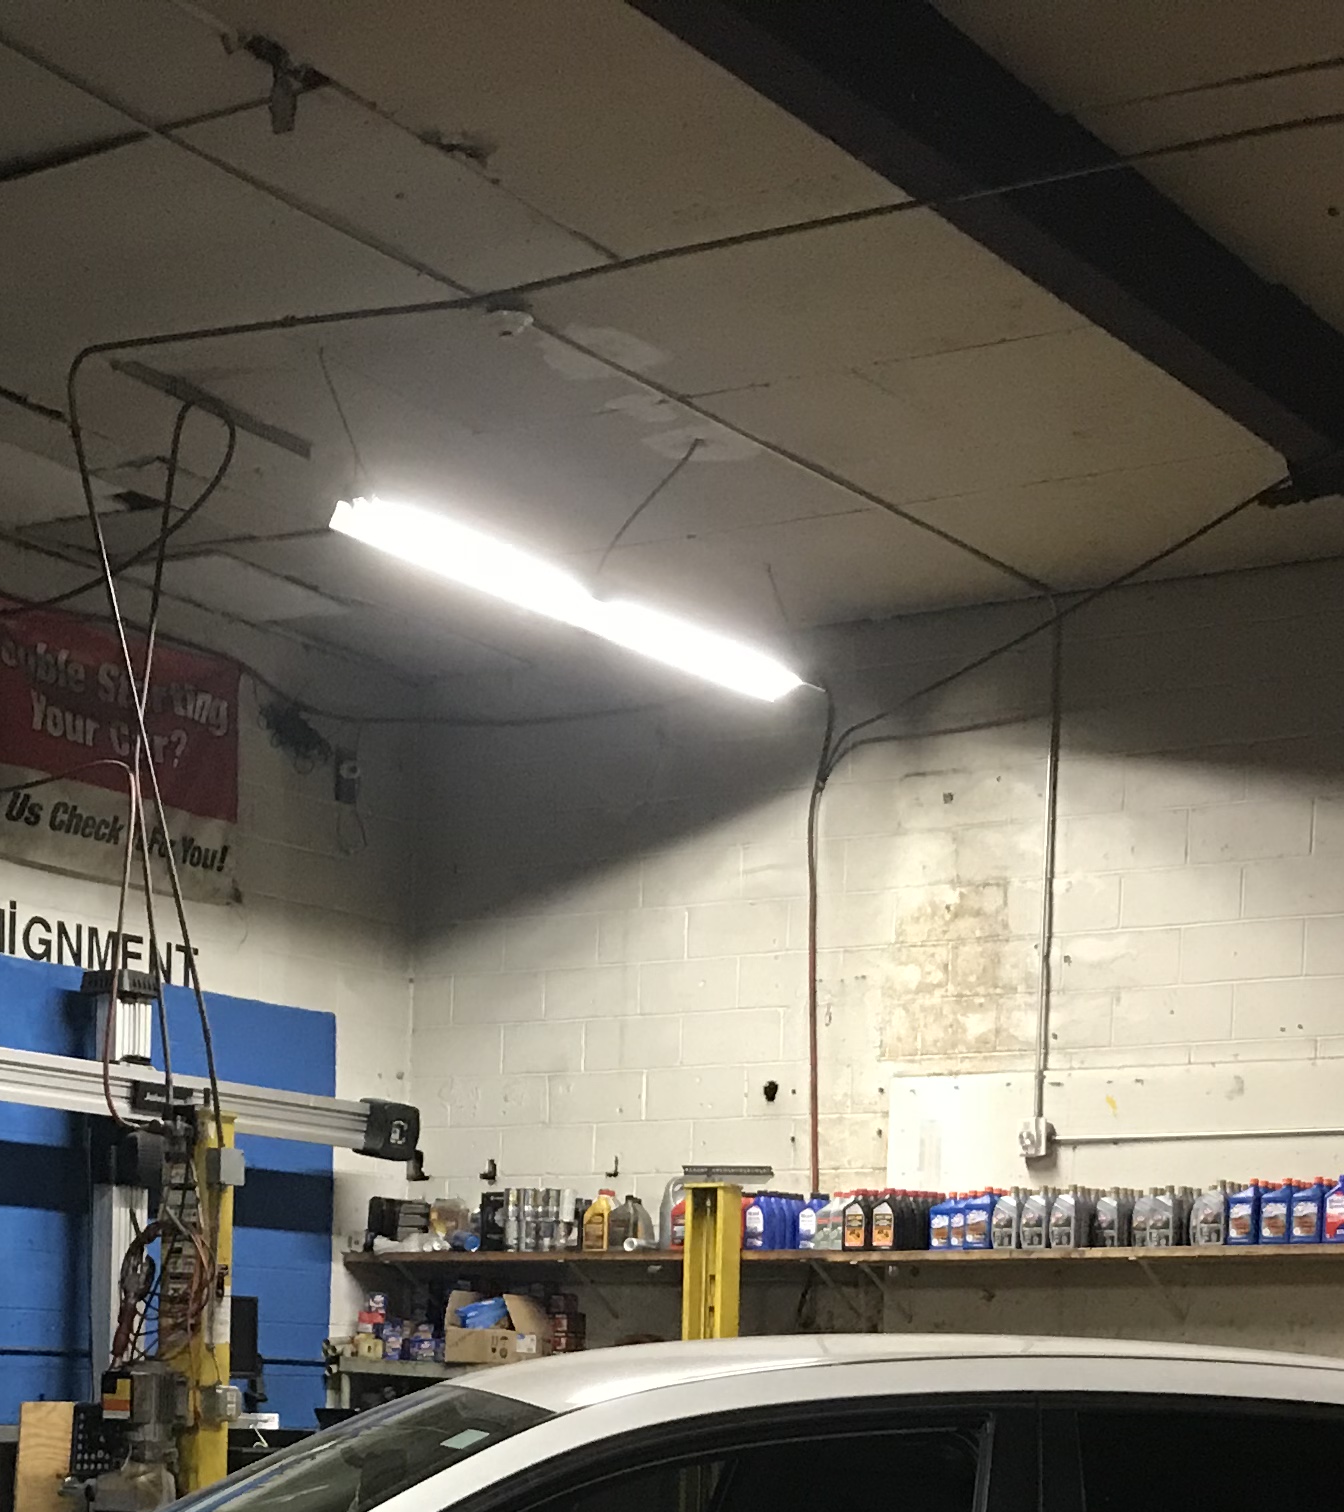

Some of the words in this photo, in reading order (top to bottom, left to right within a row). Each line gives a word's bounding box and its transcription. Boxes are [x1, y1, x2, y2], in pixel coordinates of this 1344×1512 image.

[31, 688, 100, 747] Your
[5, 790, 43, 826] Us
[49, 801, 124, 846] Check
[177, 835, 229, 872] You!
